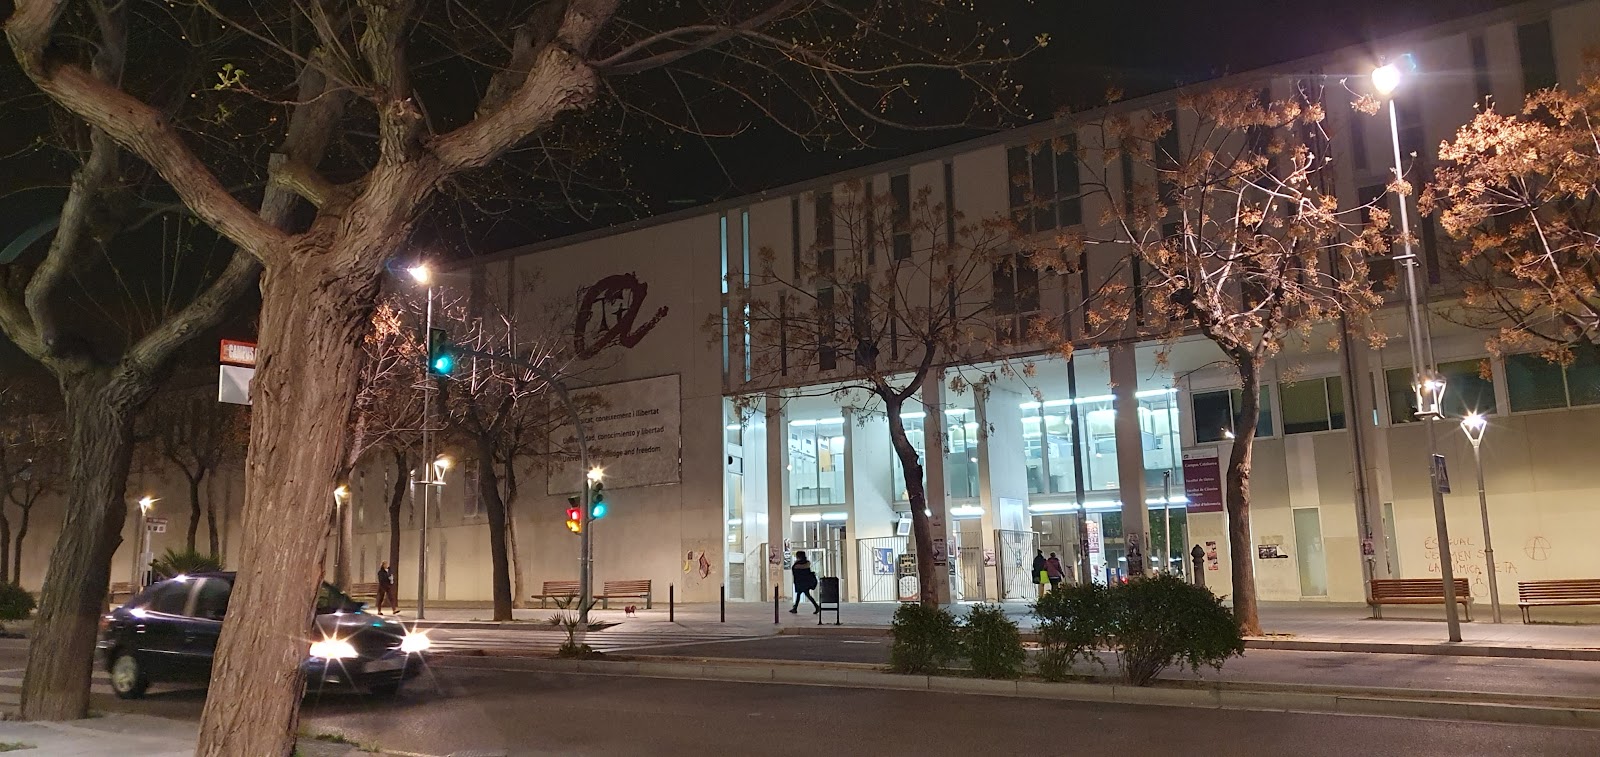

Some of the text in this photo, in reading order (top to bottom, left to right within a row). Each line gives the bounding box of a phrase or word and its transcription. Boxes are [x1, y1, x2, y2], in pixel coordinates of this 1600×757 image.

[596, 411, 632, 422] coneixement
[636, 408, 659, 417] llibertat
[597, 430, 636, 441] conocimiento
[641, 426, 665, 436] libertad
[624, 447, 635, 456] and
[636, 446, 661, 455] freedom
